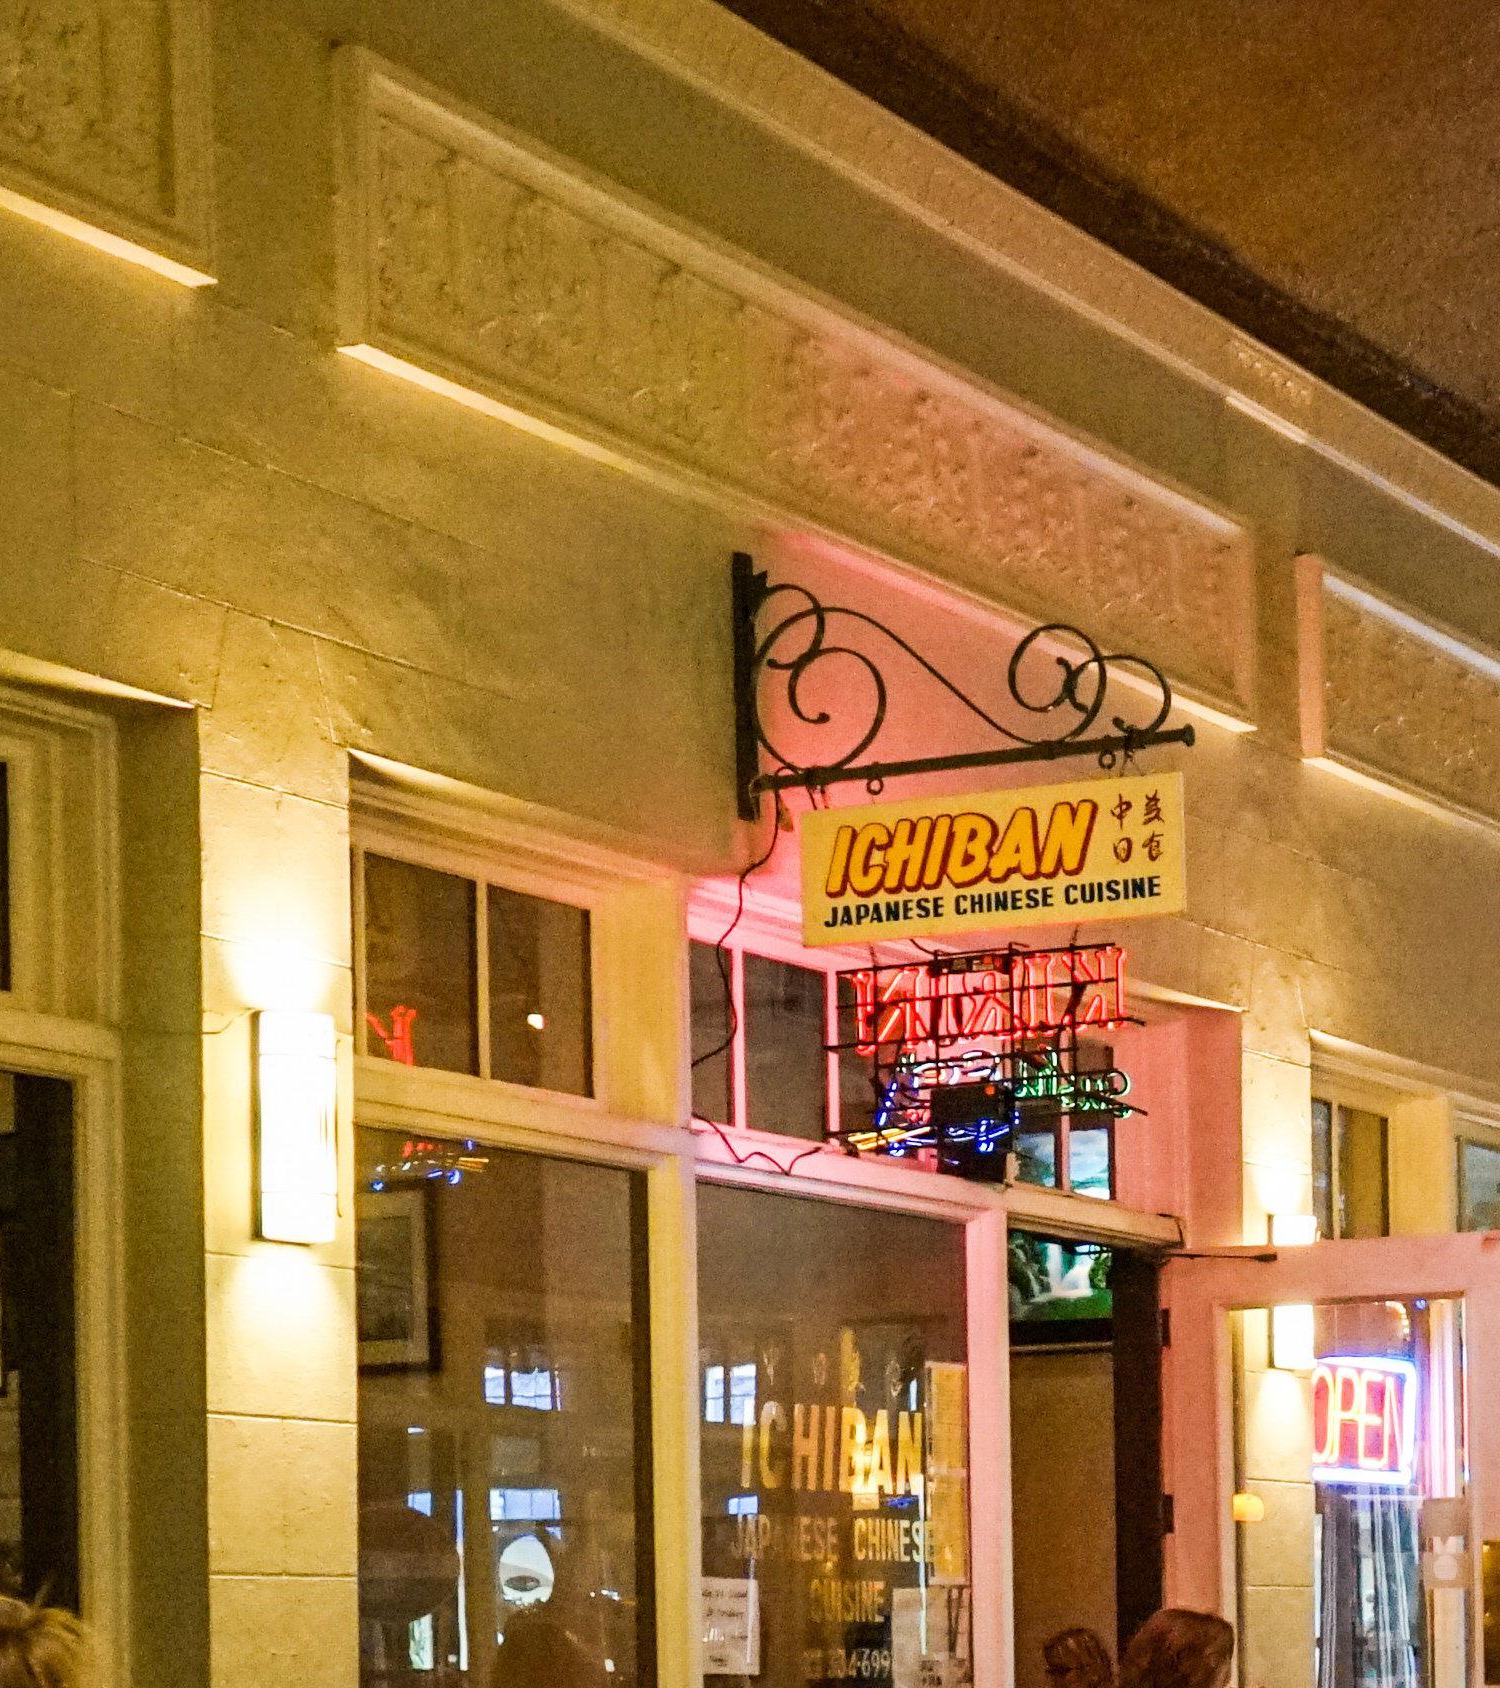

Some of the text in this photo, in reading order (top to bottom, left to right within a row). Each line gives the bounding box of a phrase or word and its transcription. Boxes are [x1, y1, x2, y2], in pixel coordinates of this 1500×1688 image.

[825, 799, 1098, 898] ICHIBAN
[824, 875, 1162, 929] JAPANESE CHINESE CUISINE
[741, 1401, 923, 1496] ICHIBAN
[1311, 1363, 1405, 1470] OPEN
[854, 1517, 935, 1563] CHINESE
[810, 1579, 885, 1624] CUISINE
